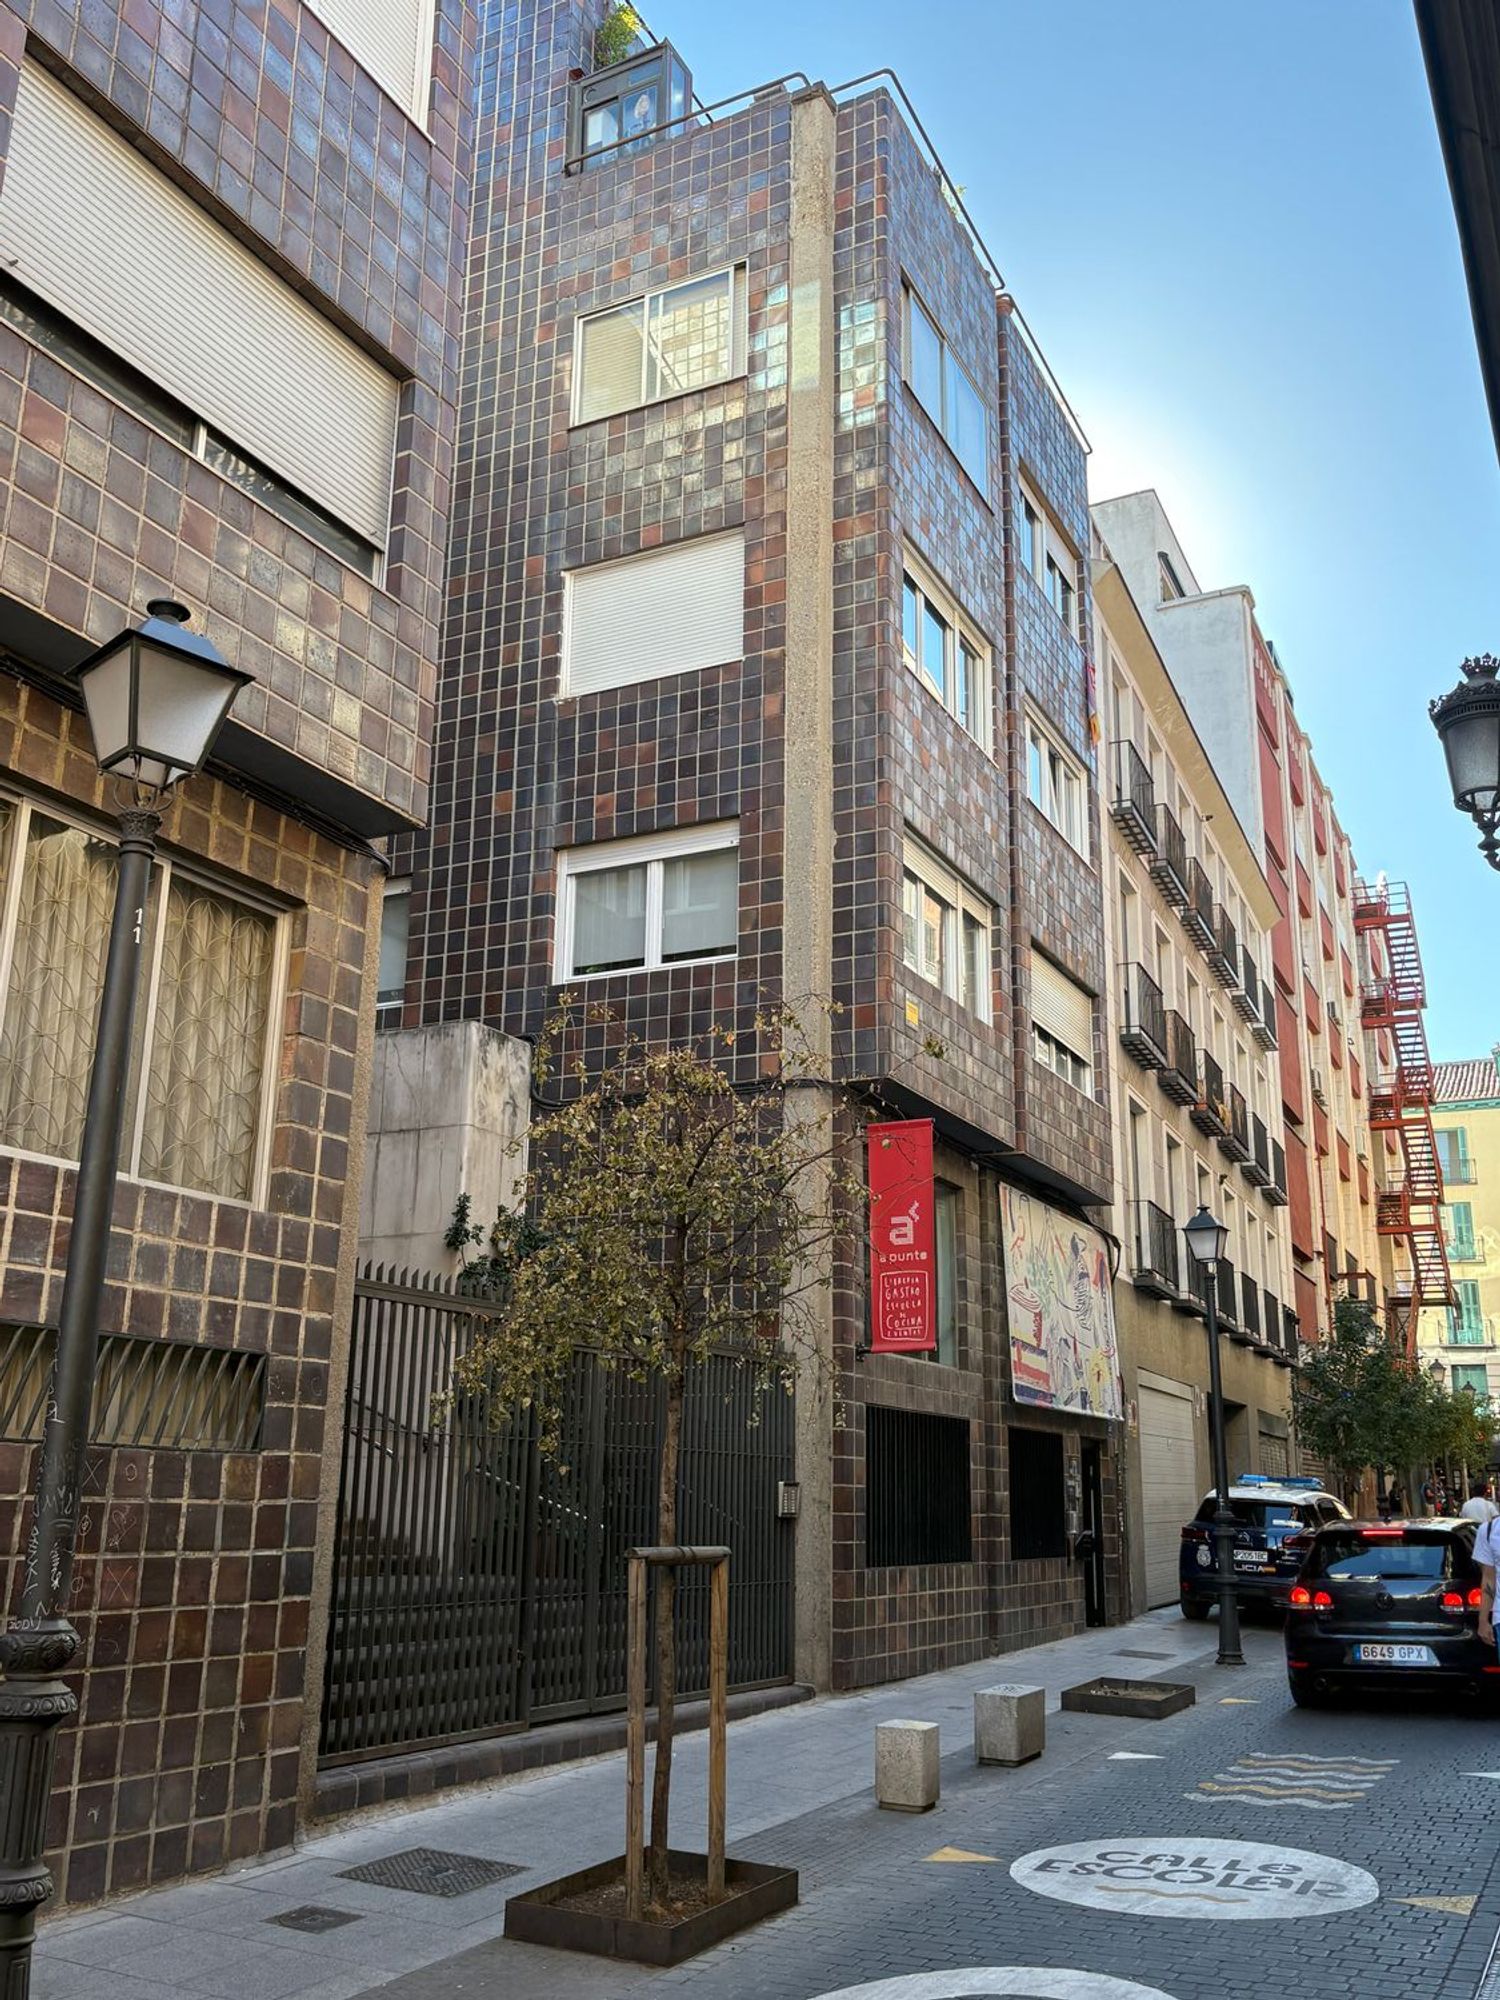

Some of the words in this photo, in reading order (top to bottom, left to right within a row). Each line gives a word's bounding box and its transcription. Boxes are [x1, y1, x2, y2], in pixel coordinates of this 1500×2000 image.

[885, 1286, 920, 1300] GASTRO
[1362, 1646, 1395, 1659] 6649
[1398, 1646, 1424, 1660] GPX
[1032, 1858, 1348, 1898] ESCOLAR
